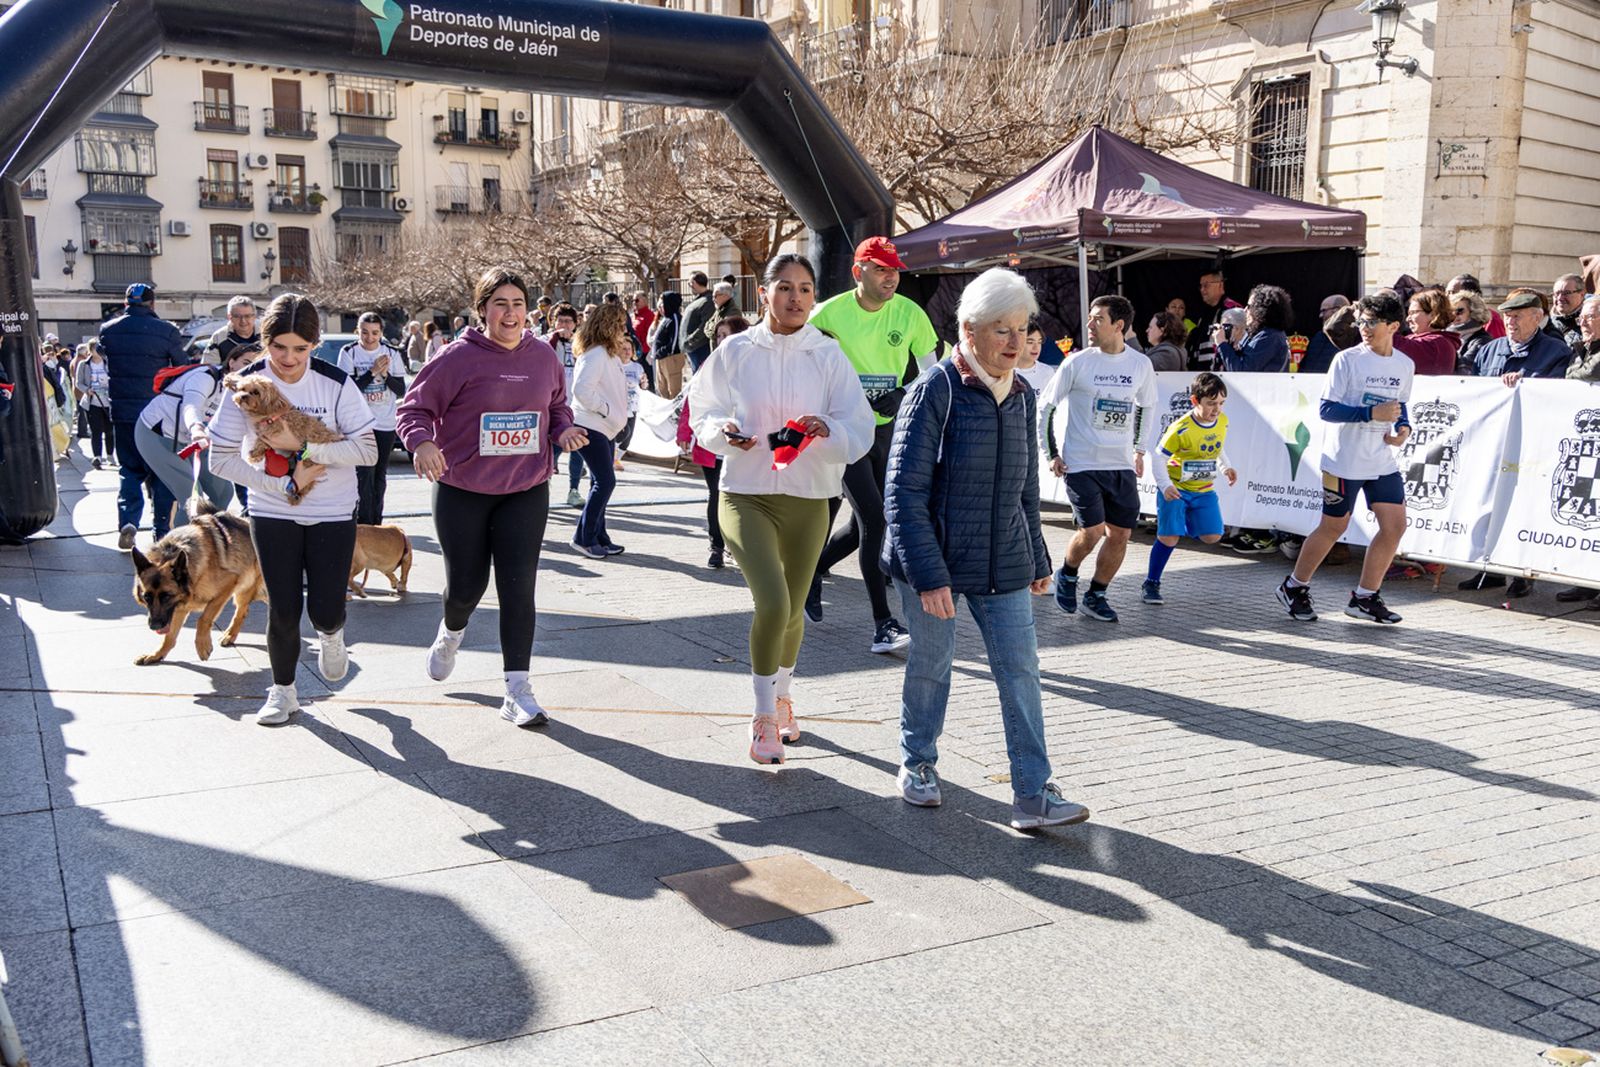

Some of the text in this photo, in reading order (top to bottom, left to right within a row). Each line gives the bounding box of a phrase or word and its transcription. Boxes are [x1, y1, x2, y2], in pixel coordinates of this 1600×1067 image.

[410, 4, 600, 42] Patronato Municipal de
[410, 24, 558, 57] Deportes de Jaén
[1104, 412, 1127, 424] 599
[490, 430, 531, 446] 1069
[1248, 481, 1323, 499] Patronato Municipa
[1256, 494, 1291, 507] Deportes
[1292, 500, 1303, 509] de
[1415, 518, 1433, 531] DE
[1518, 529, 1600, 553] CIUDAD DE
